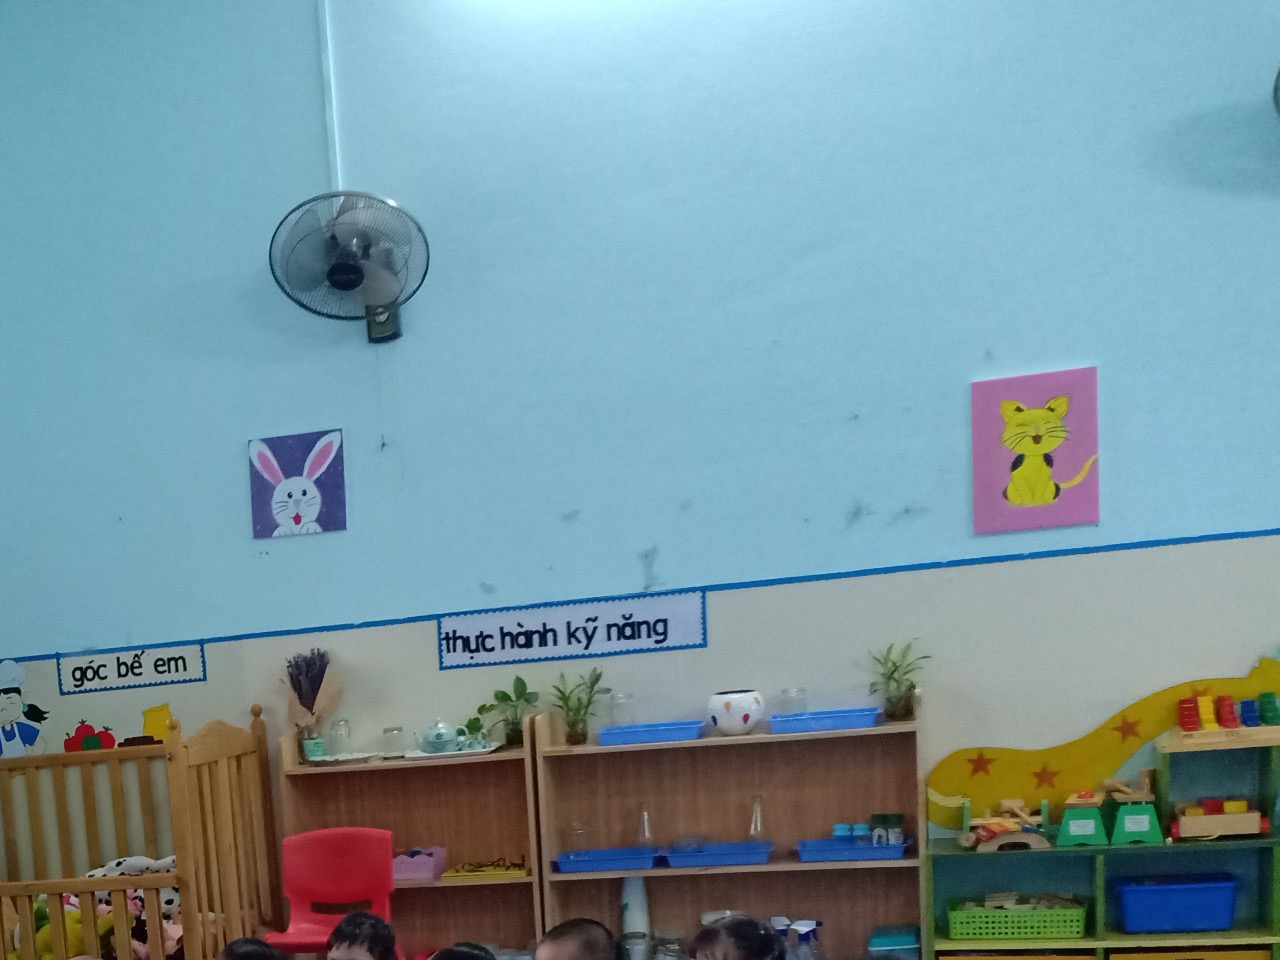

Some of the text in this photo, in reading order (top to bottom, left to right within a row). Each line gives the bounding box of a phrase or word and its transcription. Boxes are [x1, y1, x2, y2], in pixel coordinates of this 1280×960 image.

[442, 613, 669, 660] thực hành kỹ năng
[71, 650, 188, 688] góc bế em
